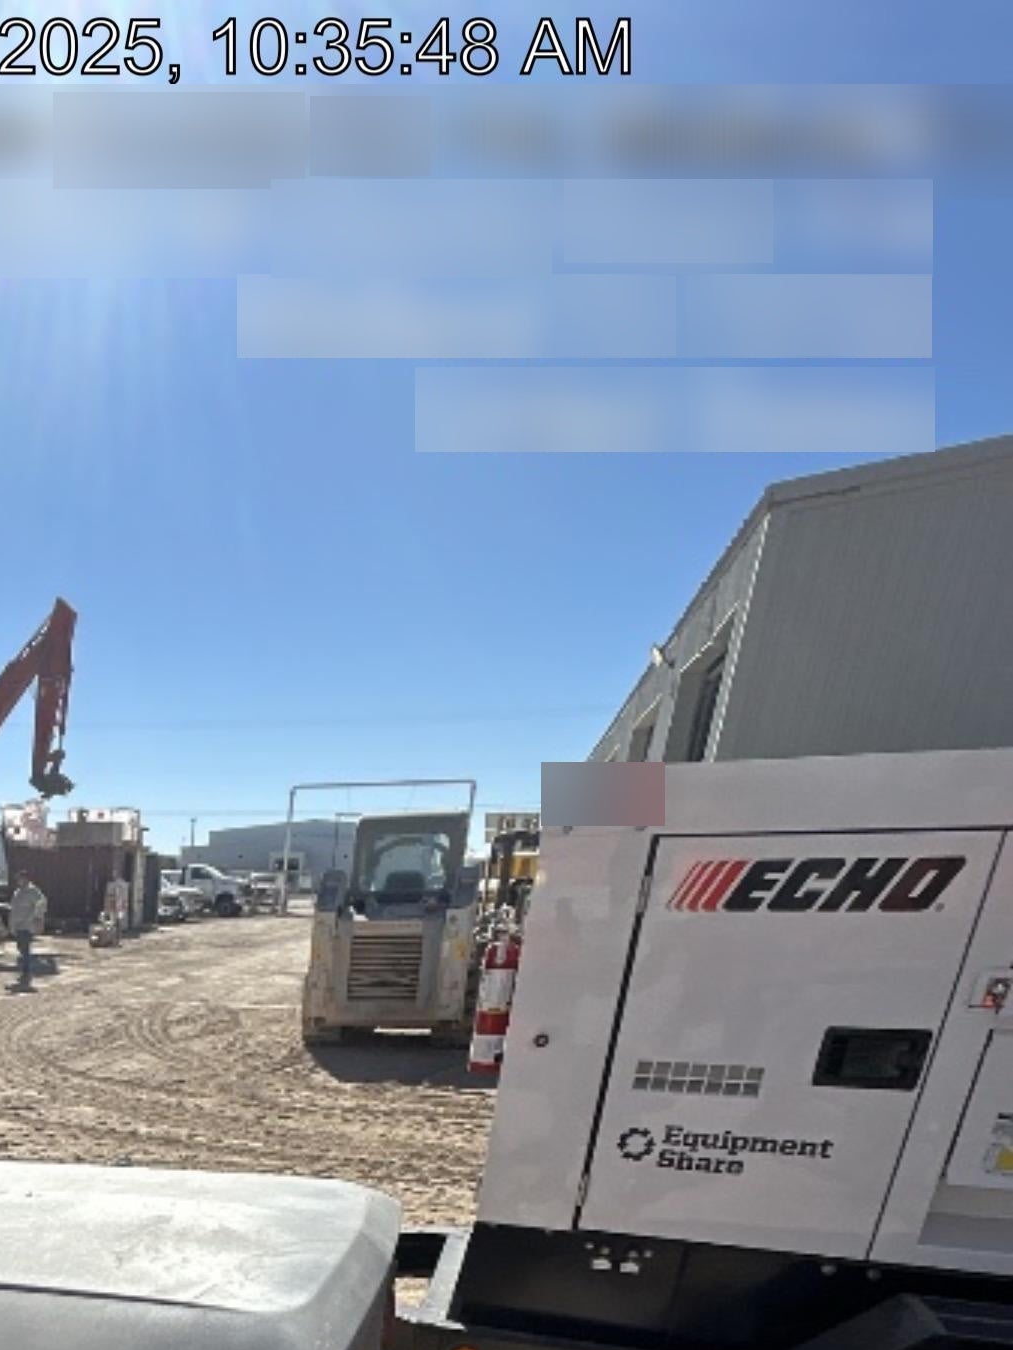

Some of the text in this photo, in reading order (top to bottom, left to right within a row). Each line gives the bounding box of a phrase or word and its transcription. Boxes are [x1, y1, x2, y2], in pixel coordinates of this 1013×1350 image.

[723, 856, 966, 912] ECHO
[662, 1124, 834, 1159] Equipment
[656, 1149, 744, 1175] Share
